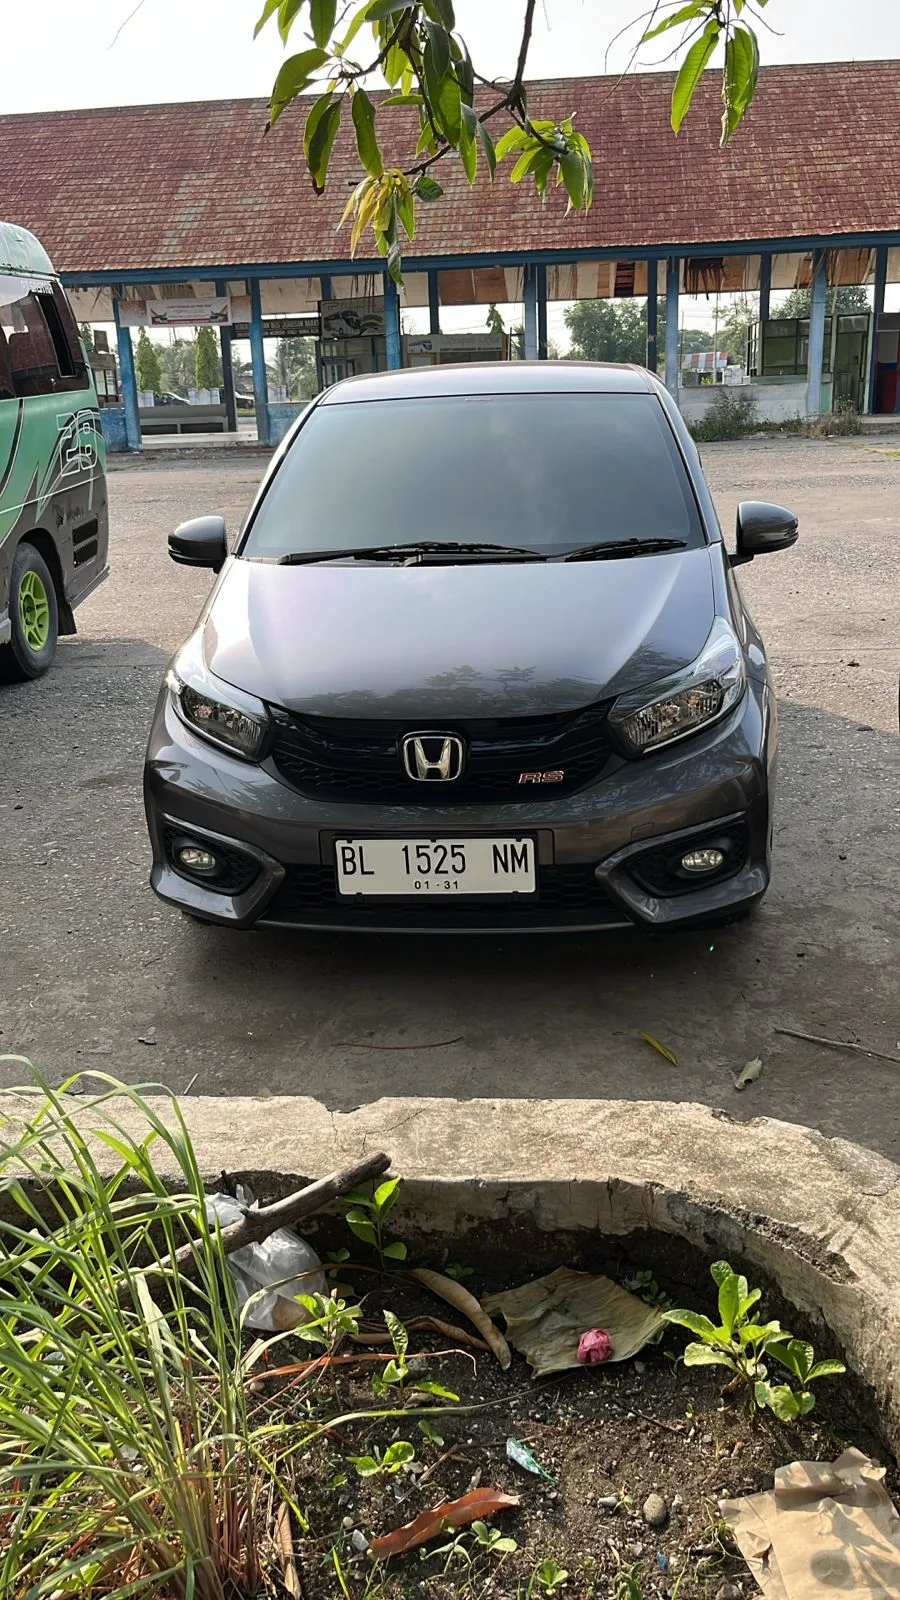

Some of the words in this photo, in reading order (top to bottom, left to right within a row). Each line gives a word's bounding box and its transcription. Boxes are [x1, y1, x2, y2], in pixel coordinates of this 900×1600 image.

[518, 770, 565, 784] RS
[341, 846, 375, 875] BL
[401, 845, 466, 874] 1525
[492, 843, 529, 873] NM
